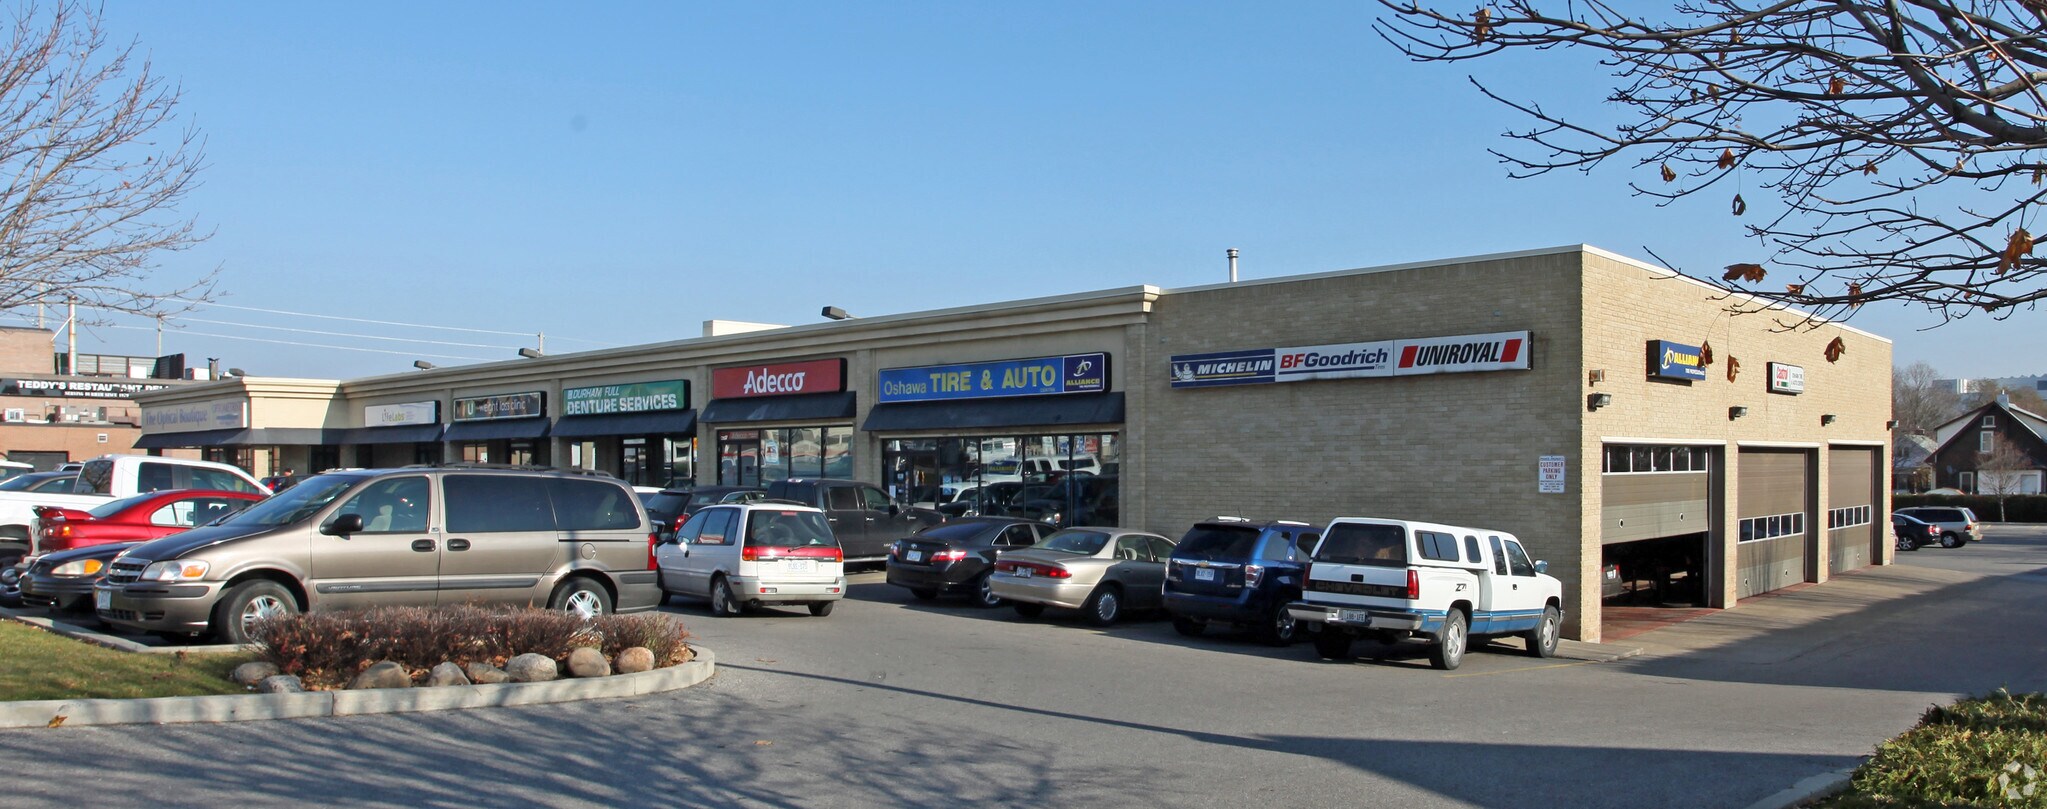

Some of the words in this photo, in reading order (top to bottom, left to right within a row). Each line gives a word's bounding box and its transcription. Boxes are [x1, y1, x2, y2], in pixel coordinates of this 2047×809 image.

[1280, 348, 1388, 369] BFGoodrich
[1416, 342, 1500, 366] UNIROYAL
[1674, 352, 1700, 367] ALLIAN
[1197, 359, 1273, 375] MICHELIN
[17, 380, 67, 390] TEDDY'S
[743, 367, 805, 394] Adecco
[884, 381, 927, 395] Oshawa
[930, 370, 972, 393] TIRE
[980, 369, 993, 391] &
[1002, 365, 1056, 389] AUTO
[573, 388, 603, 399] DURHAM
[605, 386, 619, 396] FULL
[567, 398, 618, 415] DENTURE
[620, 393, 677, 411] SERVICES
[1315, 581, 1399, 596] CHEVROLET
